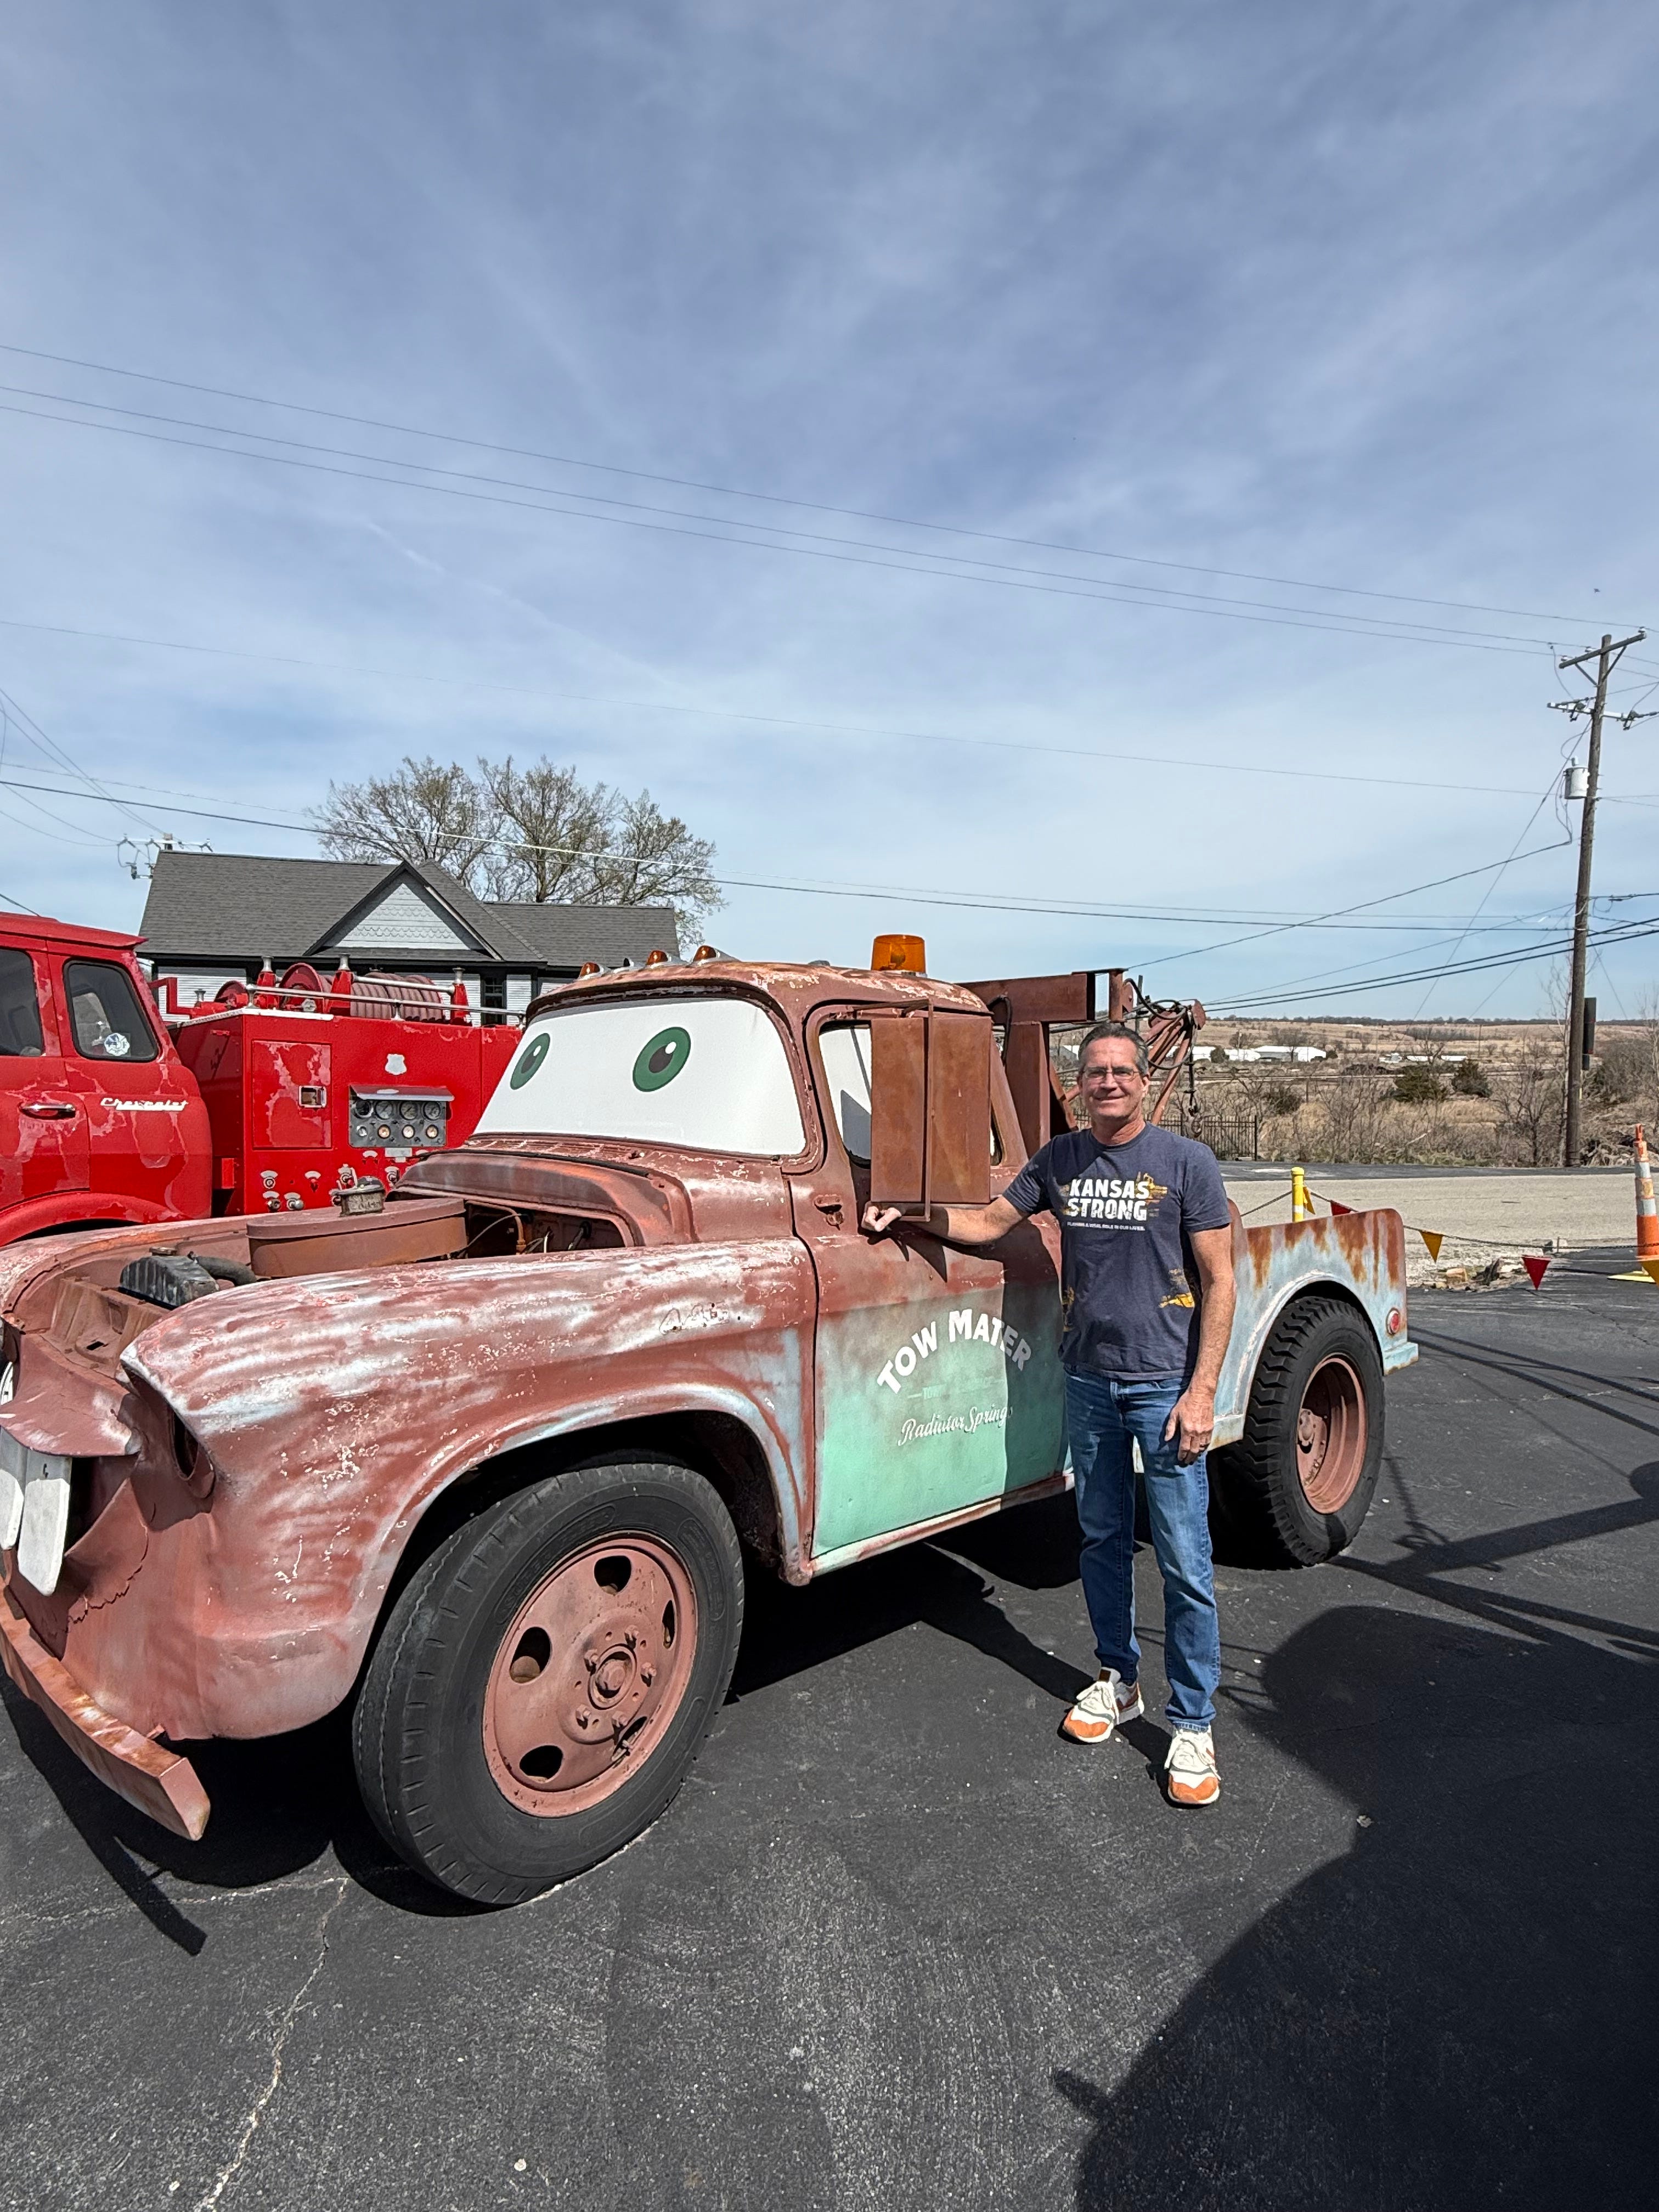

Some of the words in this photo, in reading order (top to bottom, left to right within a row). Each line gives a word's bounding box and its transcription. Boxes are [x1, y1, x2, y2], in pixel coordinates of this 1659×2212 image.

[100, 1097, 189, 1111] Chevrolet
[1070, 1179, 1149, 1199] KANSAS
[1067, 1198, 1147, 1221] STRONG
[877, 1321, 938, 1394] TOW
[949, 1308, 1031, 1371] MATER
[897, 1413, 964, 1446] Radiator
